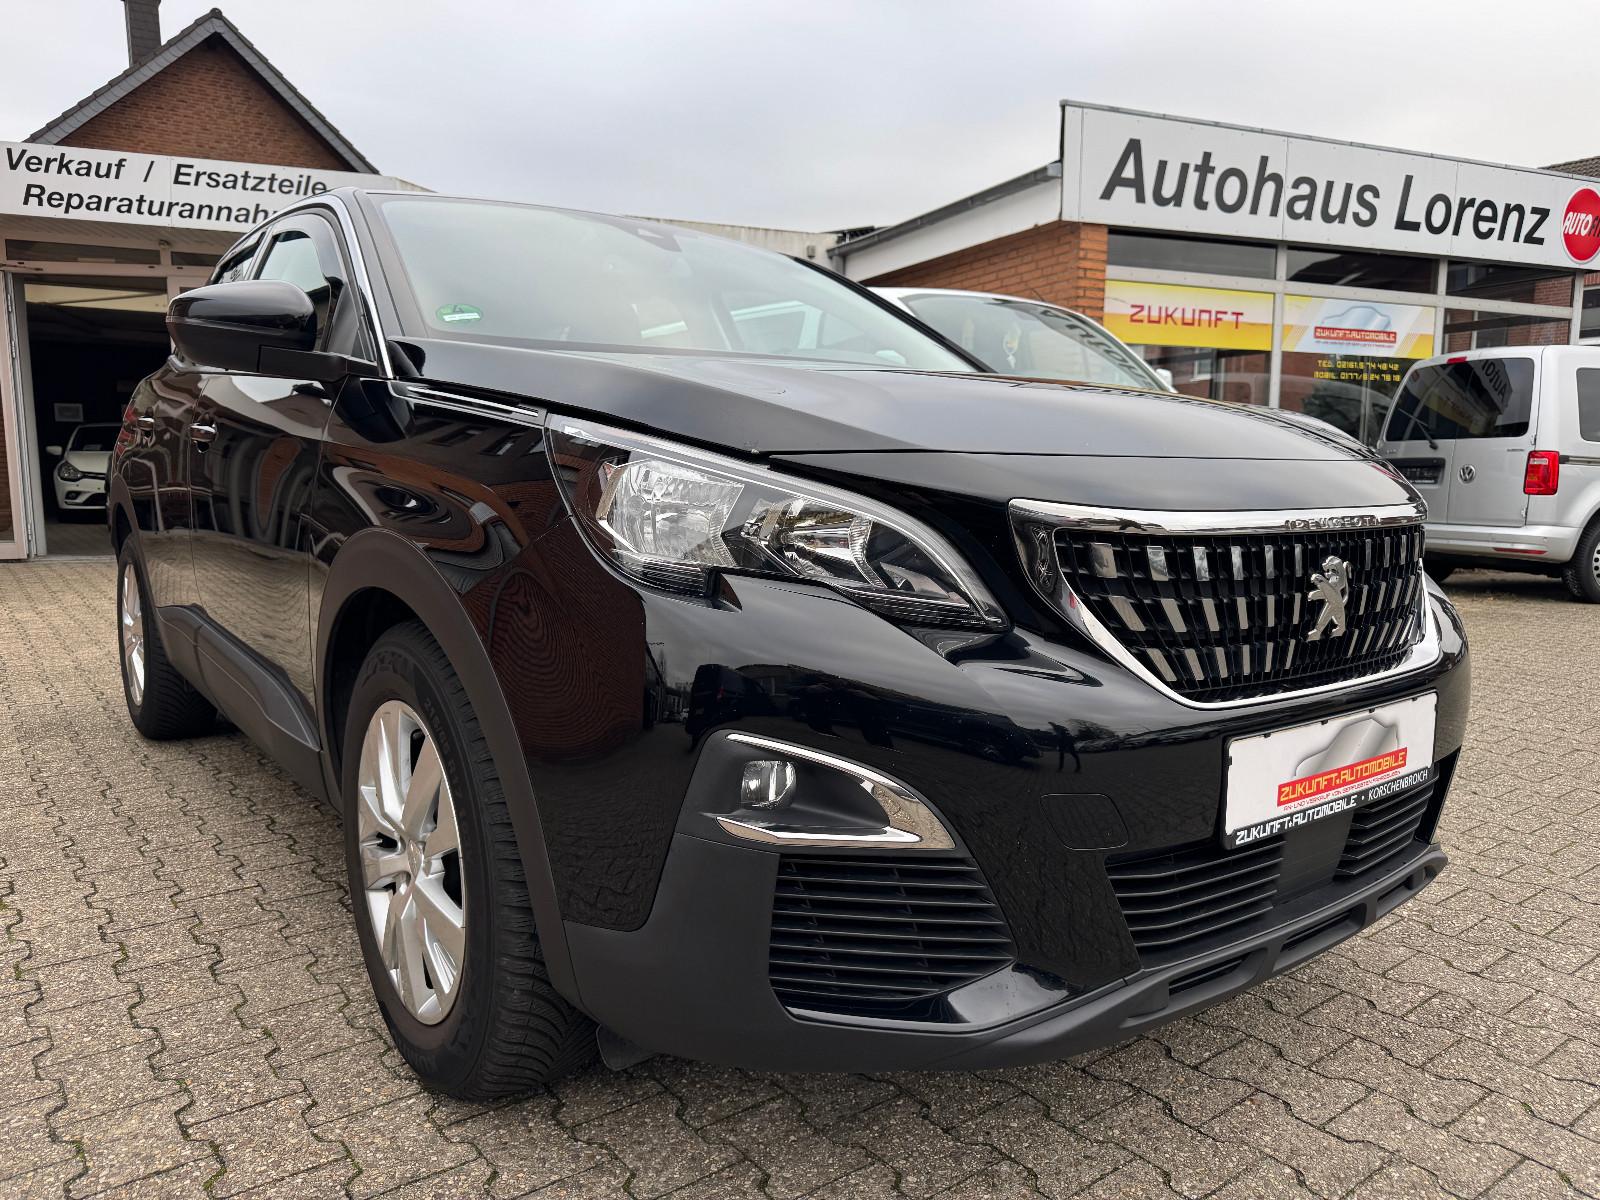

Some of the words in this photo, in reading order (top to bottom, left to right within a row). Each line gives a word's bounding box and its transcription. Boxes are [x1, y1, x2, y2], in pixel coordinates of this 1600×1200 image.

[6, 147, 127, 180] Verkauf
[143, 160, 155, 183] /
[172, 163, 328, 196] Ersatzteile
[1099, 137, 1381, 228] Autohaus
[1393, 174, 1551, 246] Lorenz
[22, 183, 276, 225] Reparaturannah
[1129, 304, 1244, 329] ZUKUNFT
[1367, 769, 1428, 801] KORSCHENBROICH
